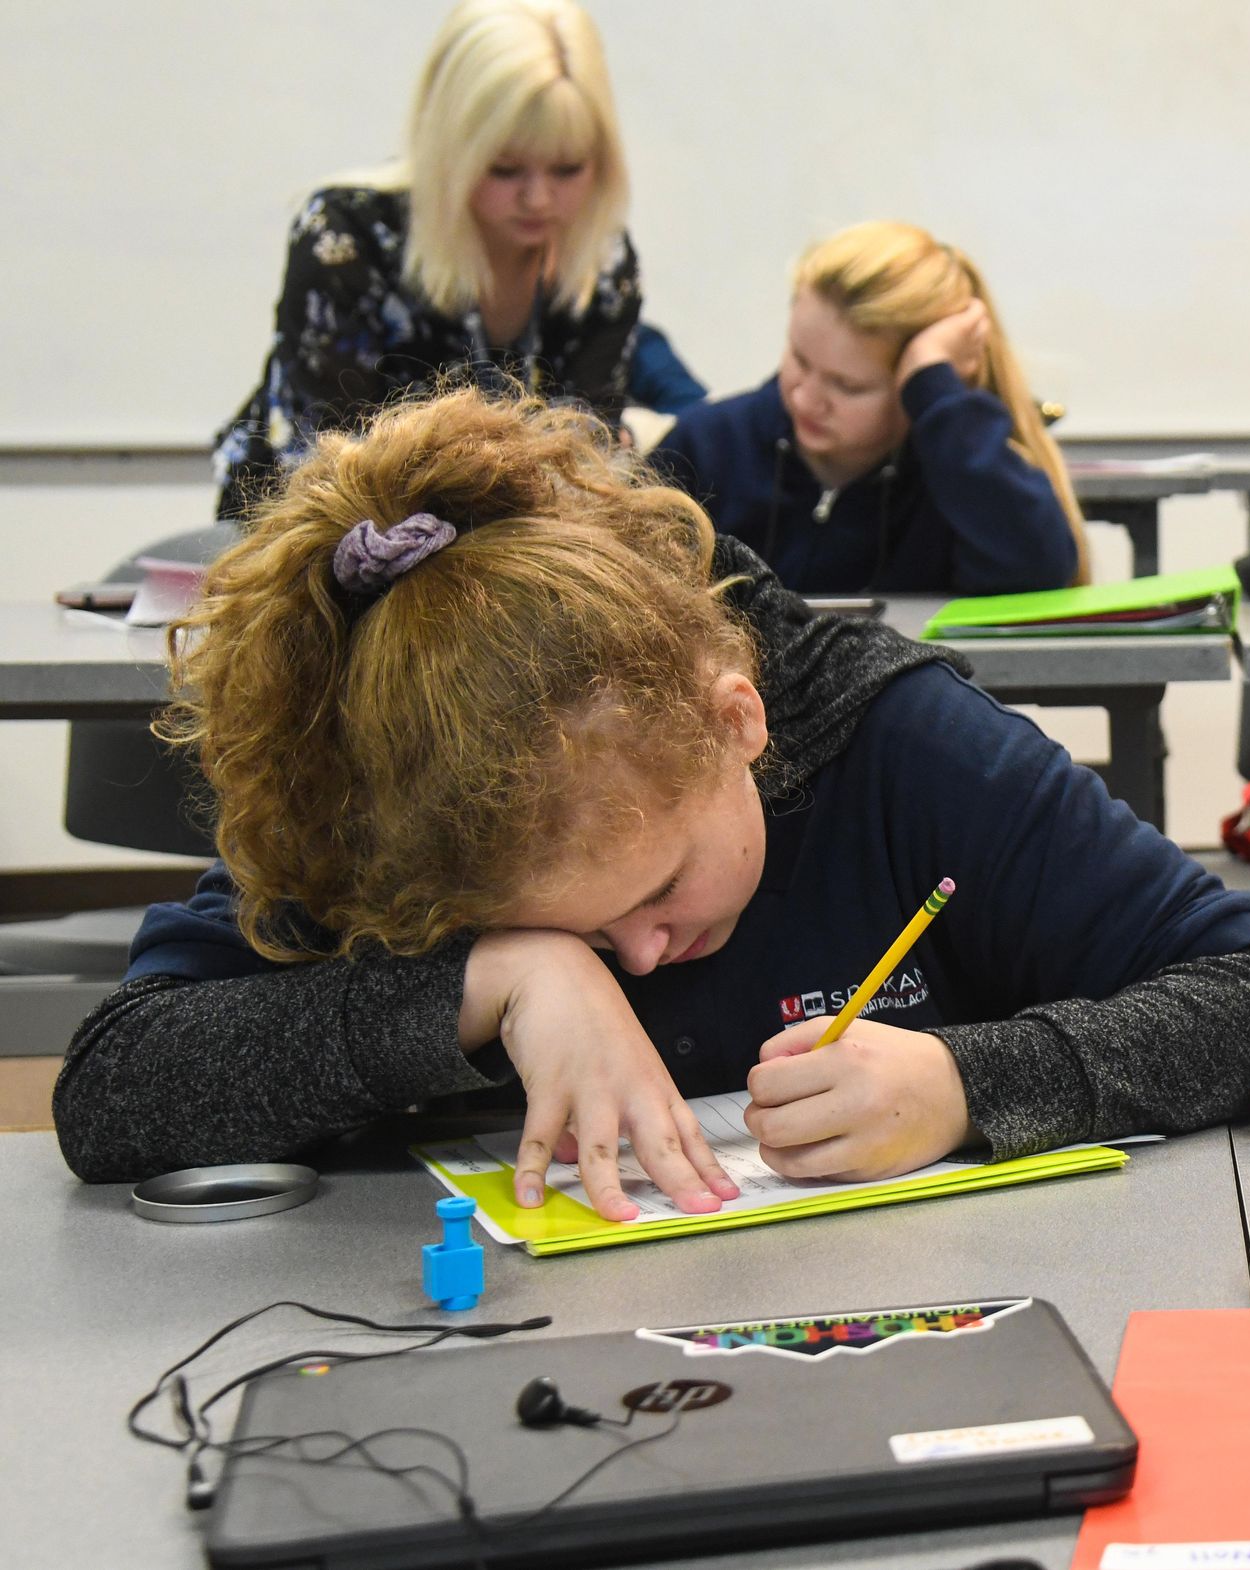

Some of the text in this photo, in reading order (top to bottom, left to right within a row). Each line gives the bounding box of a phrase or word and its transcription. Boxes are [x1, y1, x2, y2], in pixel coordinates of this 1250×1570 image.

[830, 967, 924, 1009] SPKAN
[692, 1313, 984, 1350] SHOSHONE
[697, 1304, 982, 1337] MOUNTAIN RETREAT
[637, 1379, 719, 1413] hp
